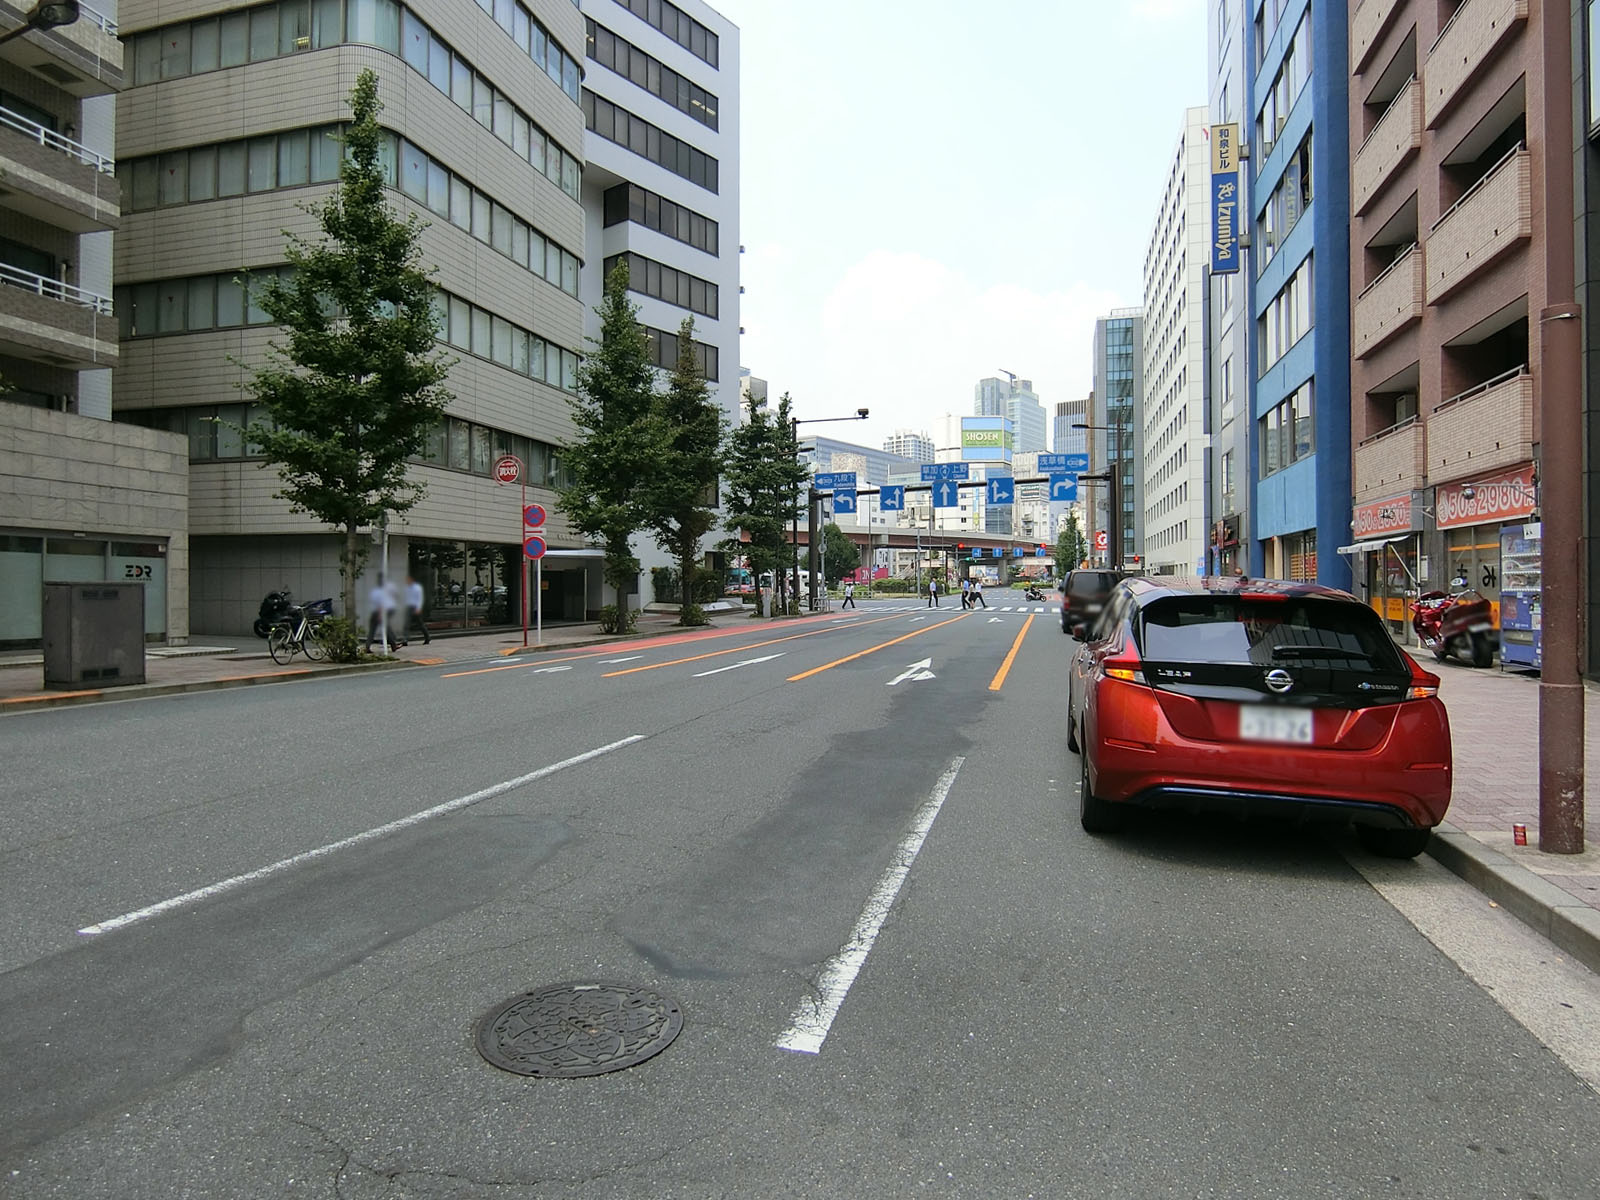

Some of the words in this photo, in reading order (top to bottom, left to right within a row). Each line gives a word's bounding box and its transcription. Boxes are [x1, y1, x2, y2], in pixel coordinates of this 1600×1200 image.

[1219, 128, 1230, 169] 和泉ビル
[1215, 201, 1236, 261] Izumiya
[966, 432, 999, 441] SHOSEN
[125, 565, 152, 577] ZDR
